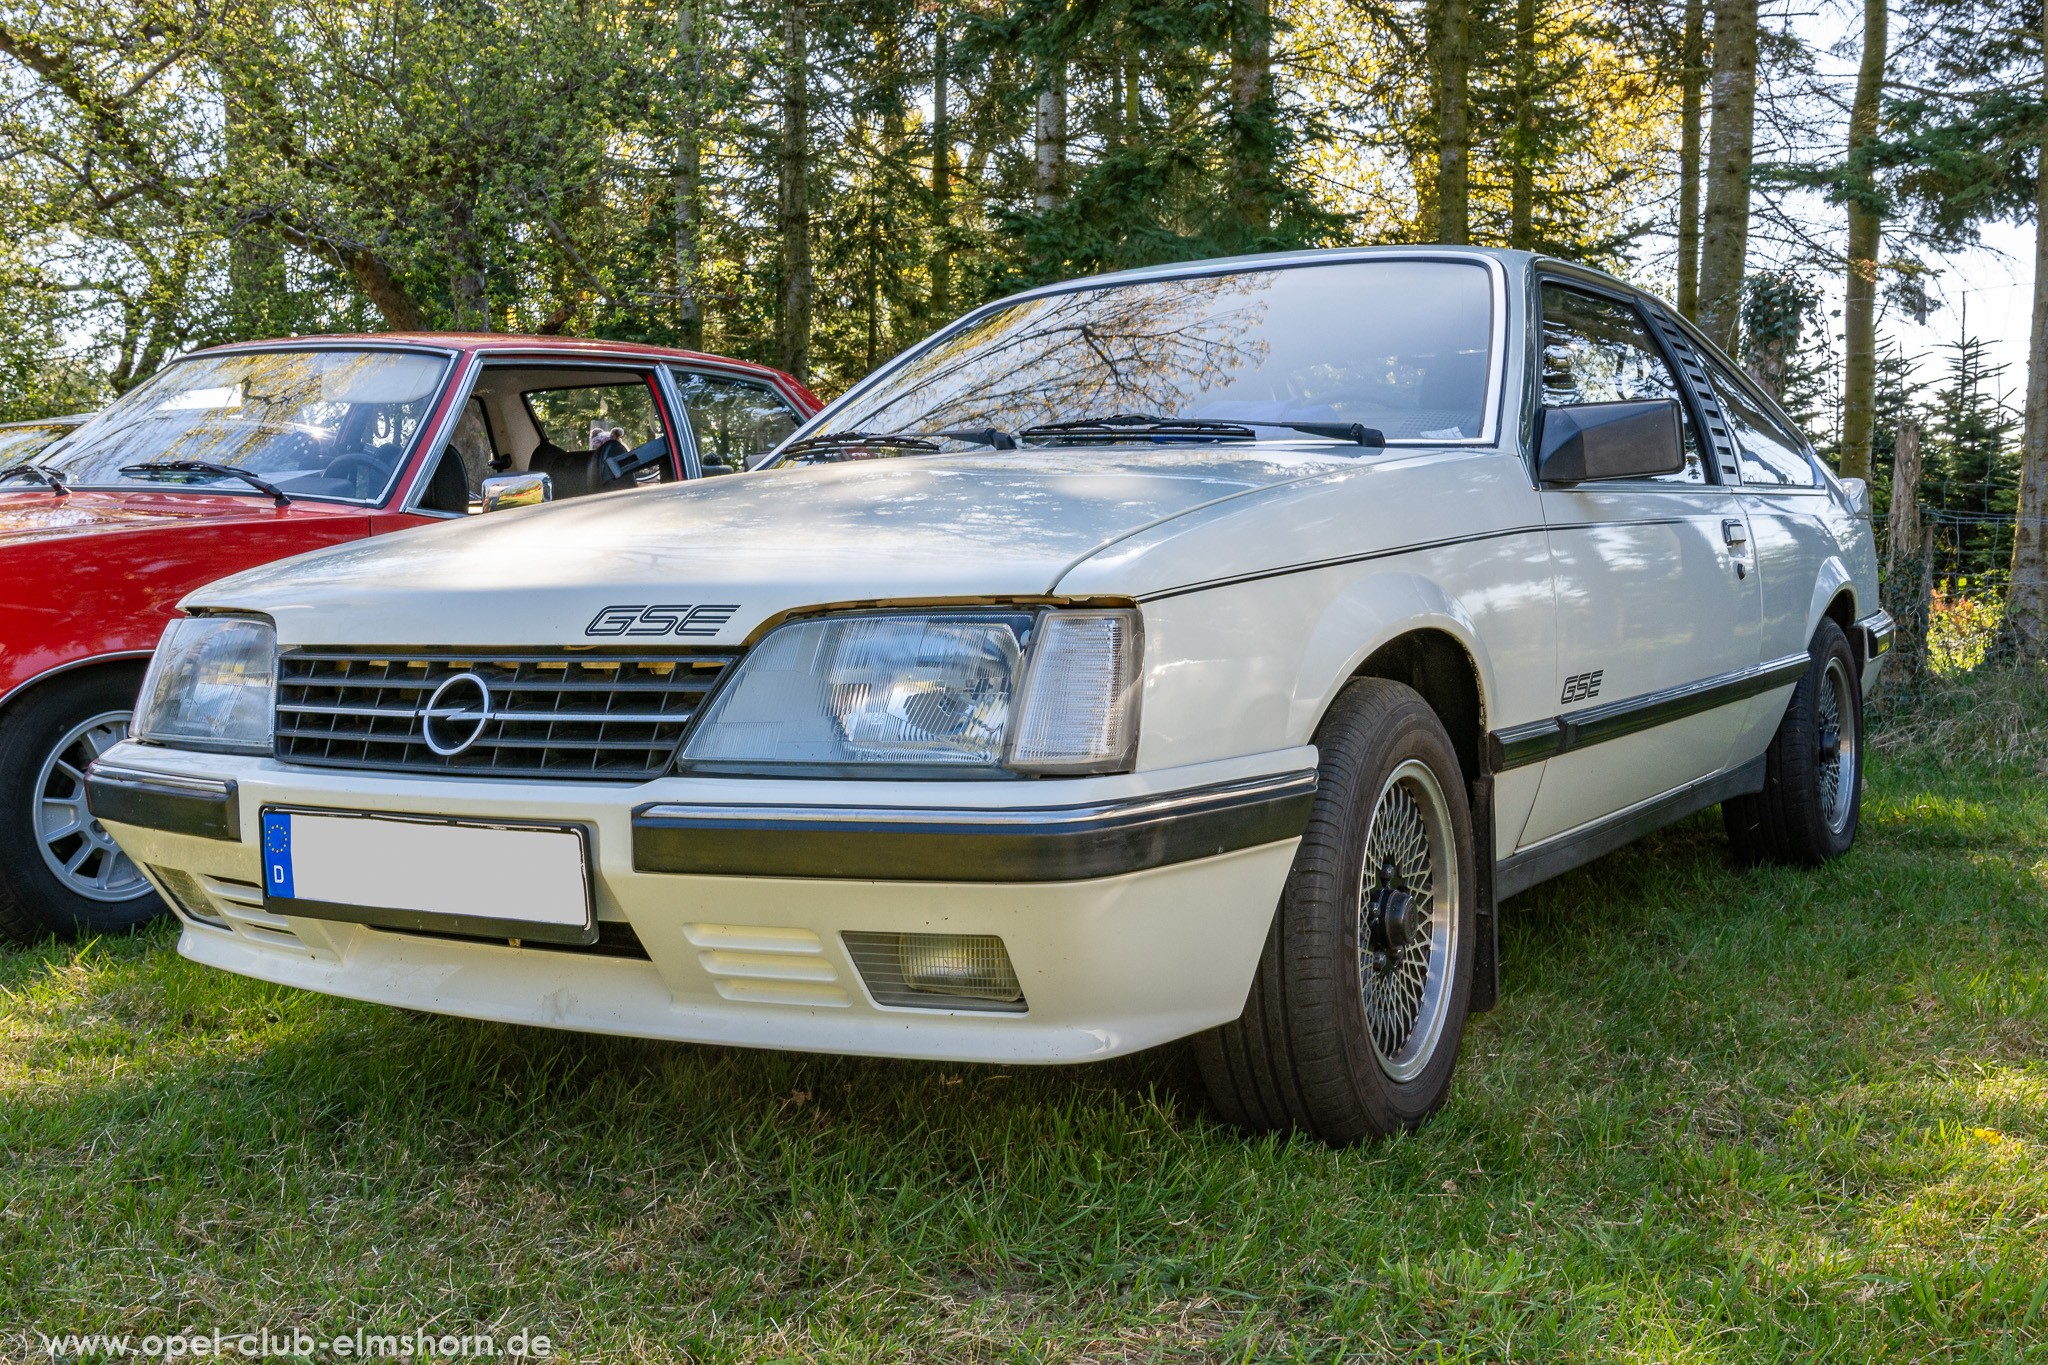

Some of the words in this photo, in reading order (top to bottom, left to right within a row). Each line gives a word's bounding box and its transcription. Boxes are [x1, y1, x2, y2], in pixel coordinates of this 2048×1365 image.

[585, 605, 741, 636] GSE
[1561, 669, 1604, 704] GSE
[273, 865, 284, 883] D
